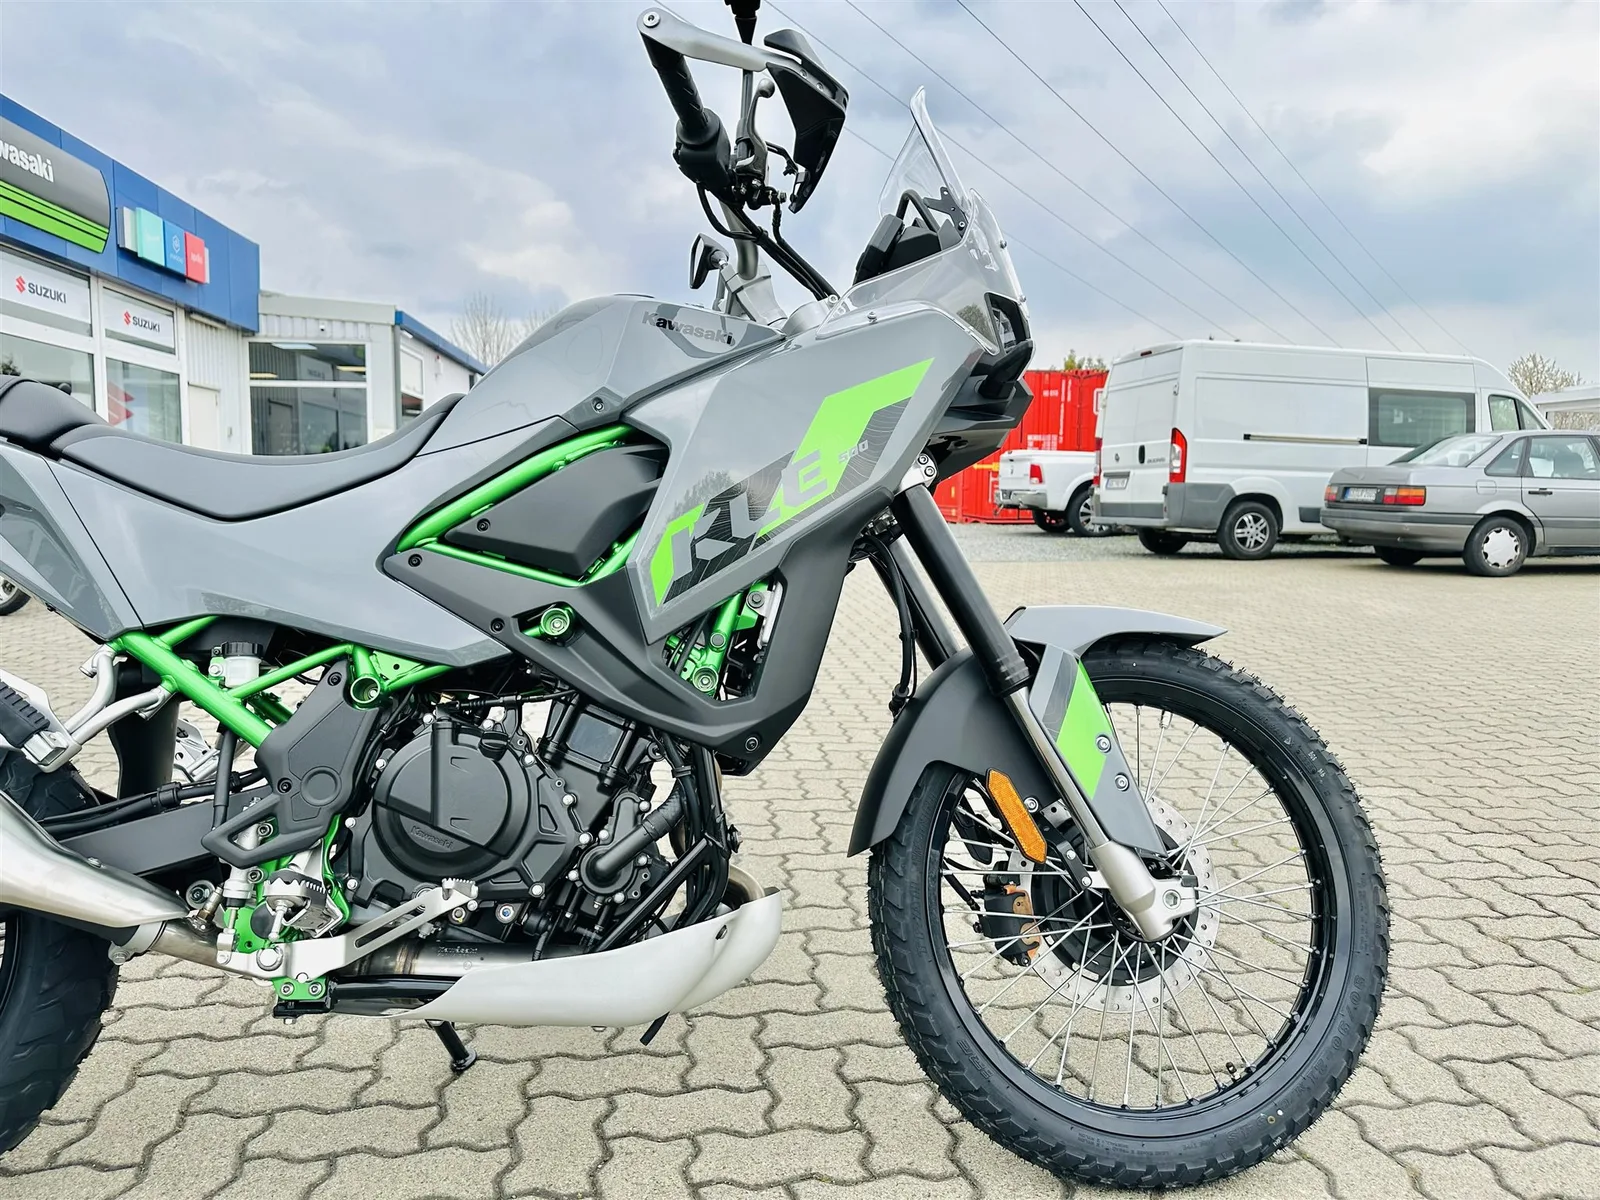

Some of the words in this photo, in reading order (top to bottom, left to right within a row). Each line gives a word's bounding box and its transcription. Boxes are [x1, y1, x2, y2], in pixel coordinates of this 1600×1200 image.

[28, 282, 66, 304] SUZUKI
[132, 316, 160, 332] SUZUKI
[642, 311, 734, 345] Kawasaki
[671, 450, 828, 582] KLE
[838, 440, 869, 464] 500
[410, 825, 454, 850] Kawasaki
